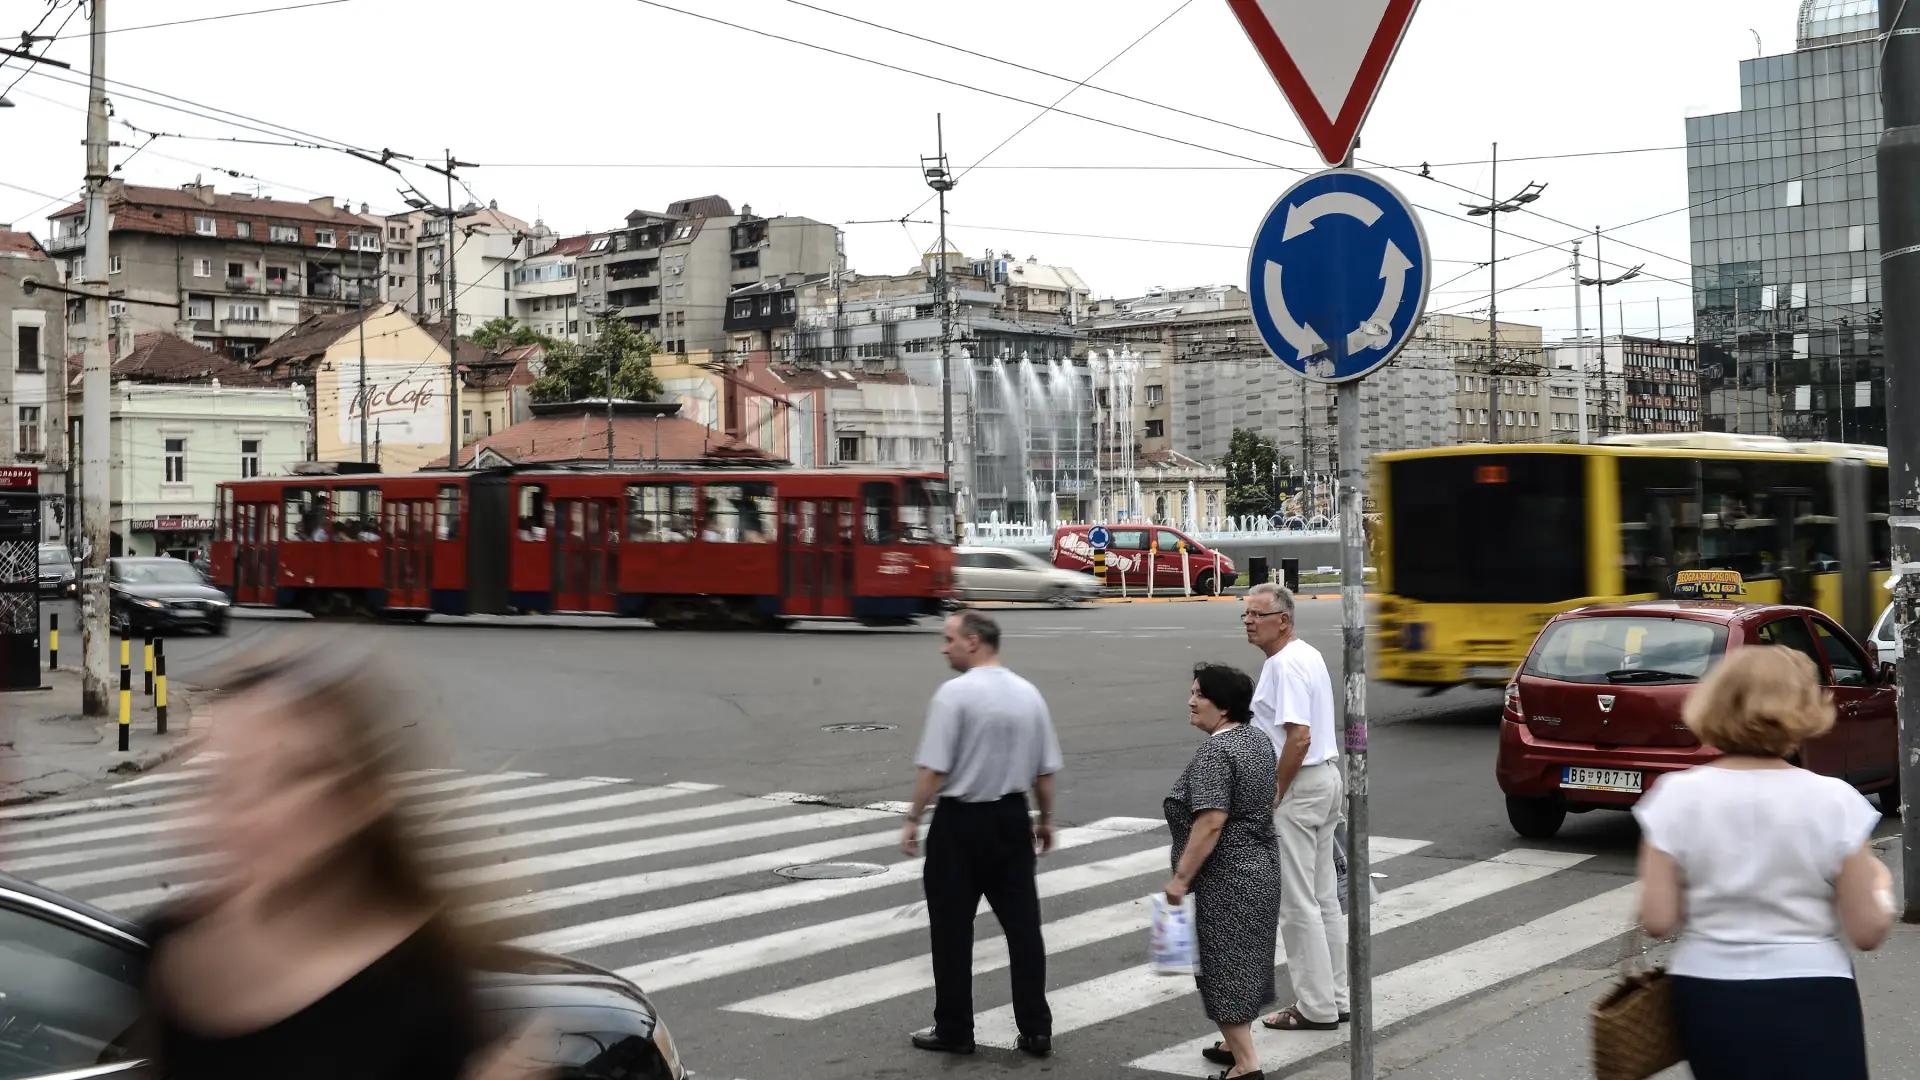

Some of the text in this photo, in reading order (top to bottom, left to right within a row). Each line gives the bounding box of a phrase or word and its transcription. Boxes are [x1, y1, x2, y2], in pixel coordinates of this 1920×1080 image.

[181, 519, 219, 529] ПЕКАРА
[1695, 582, 1721, 593] TAXI
[1571, 769, 1586, 783] BG
